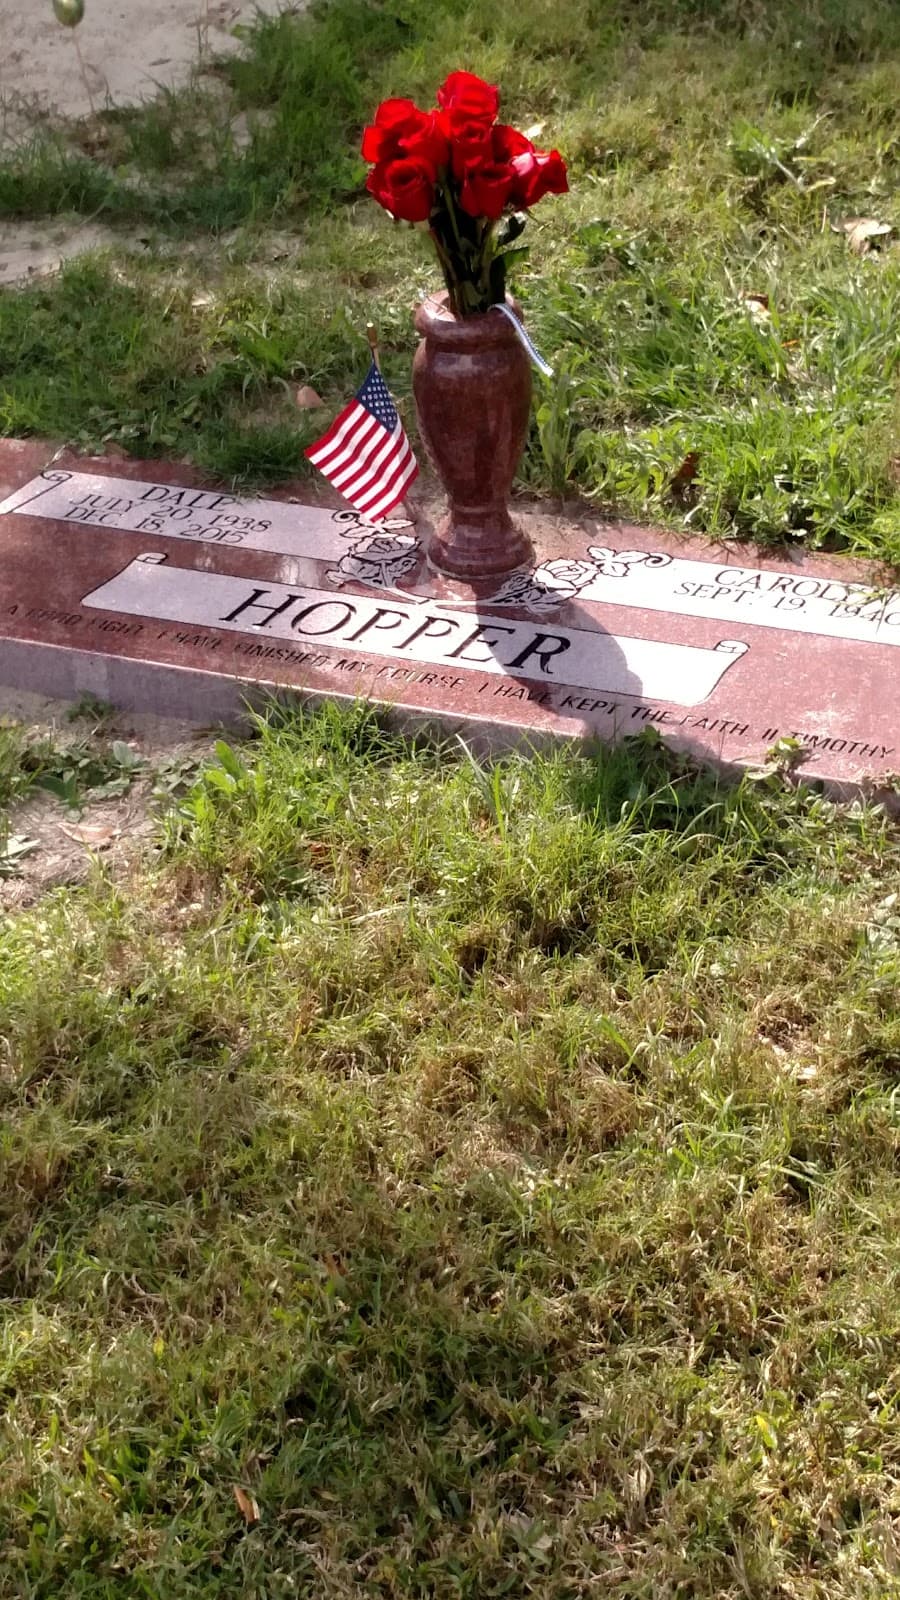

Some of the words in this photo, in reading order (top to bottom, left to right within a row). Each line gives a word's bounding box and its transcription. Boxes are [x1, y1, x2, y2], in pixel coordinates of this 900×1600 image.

[70, 494, 143, 513] JULY
[208, 514, 272, 532] 1938
[138, 485, 236, 512] DALE
[64, 507, 122, 526] DEC.
[180, 523, 249, 543] 2015
[673, 582, 754, 605] SEPT.
[219, 588, 572, 674] HOPPER
[234, 643, 330, 667] FINISHED
[334, 659, 374, 673] MY
[478, 682, 489, 693] I
[493, 685, 553, 705] HAVE
[560, 695, 622, 715] KEPT
[631, 705, 673, 724] THE
[761, 728, 779, 740] II
[791, 731, 895, 758] TIMOTHY
